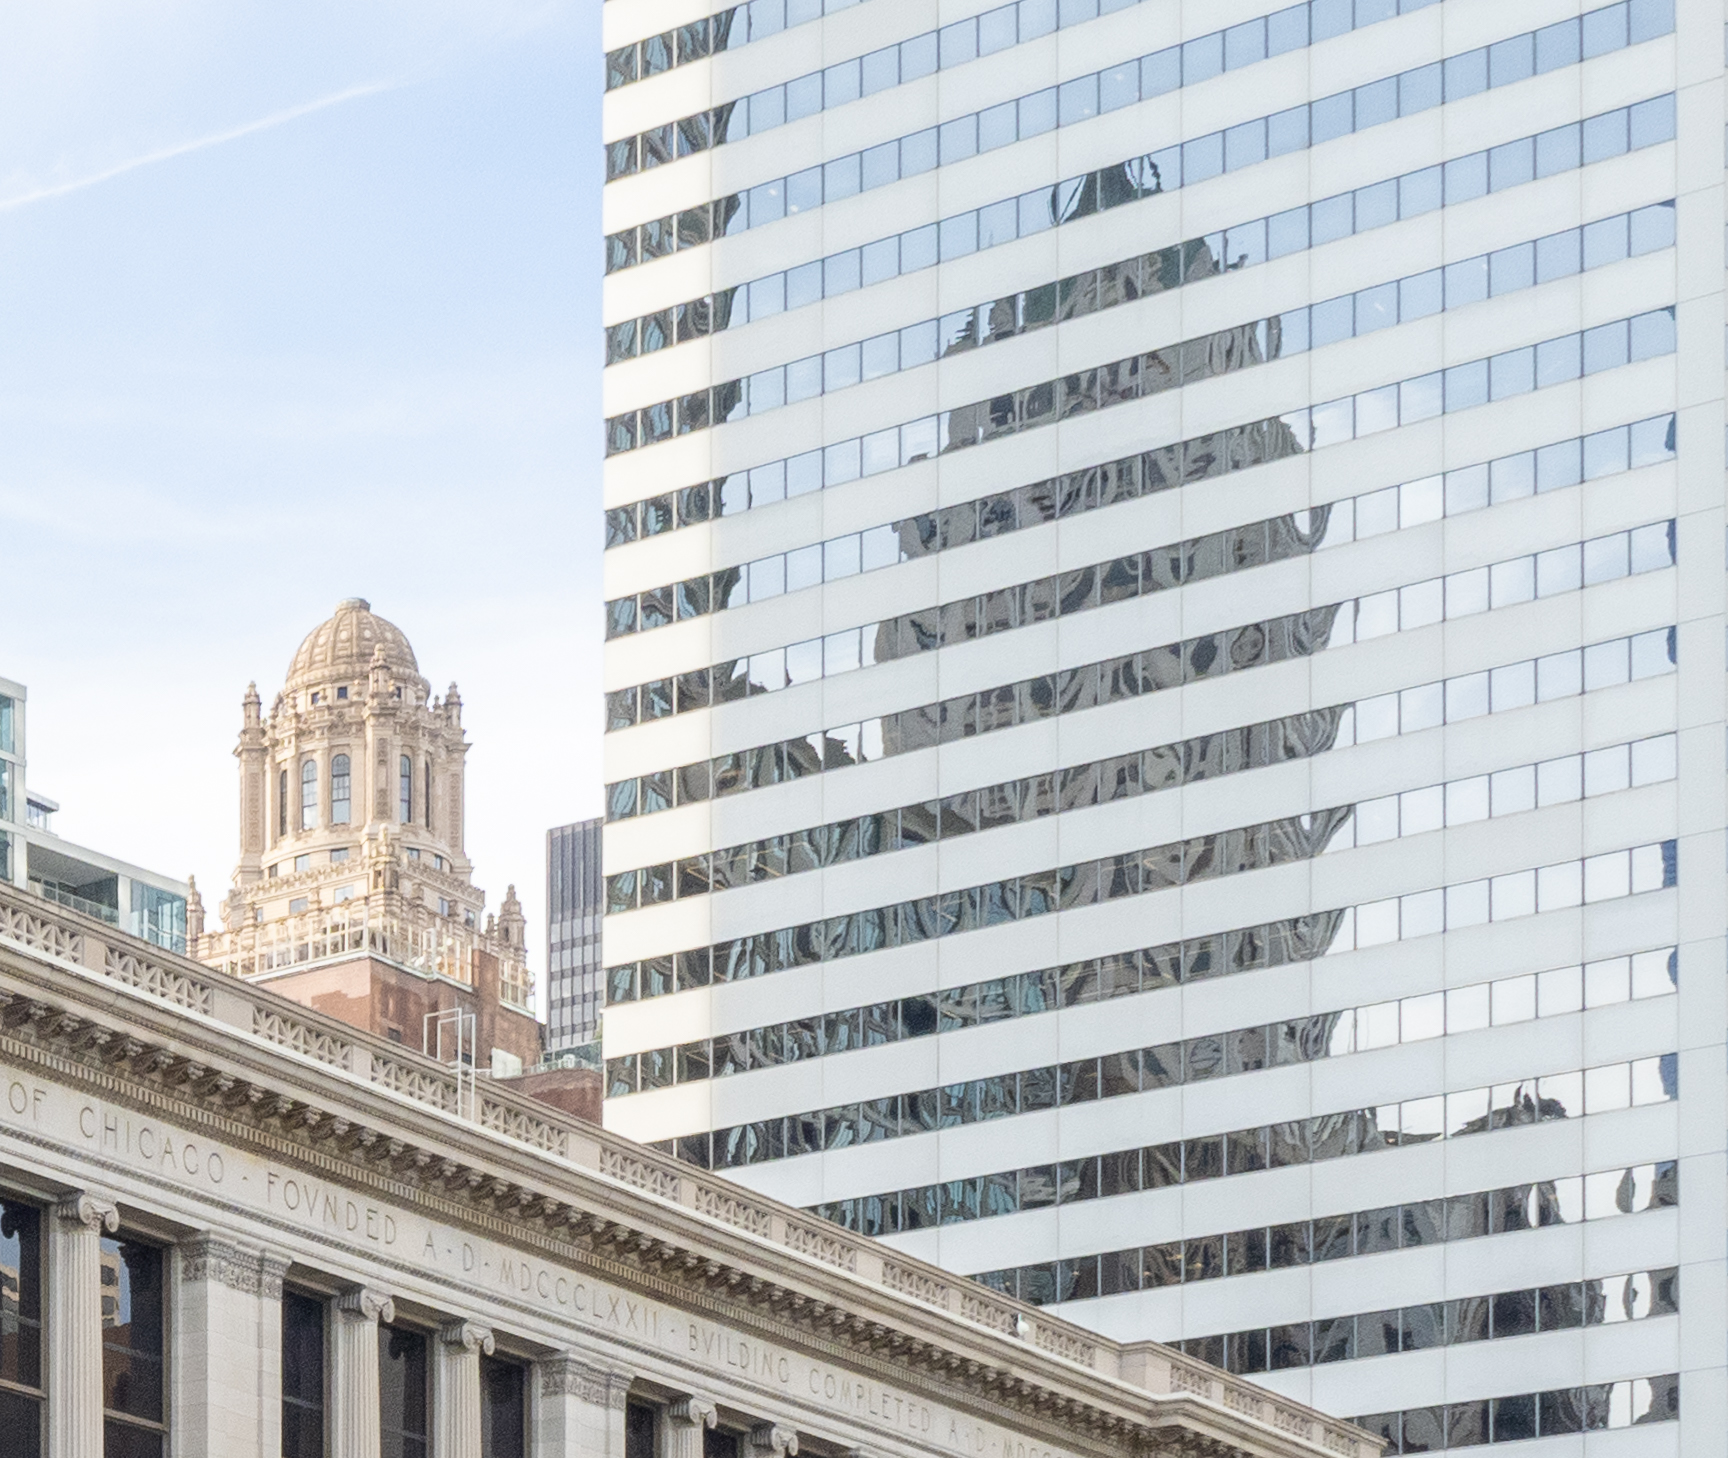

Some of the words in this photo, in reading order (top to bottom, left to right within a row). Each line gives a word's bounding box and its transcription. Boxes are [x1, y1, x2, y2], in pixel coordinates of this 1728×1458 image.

[8, 1080, 48, 1122] OF
[79, 1105, 226, 1184] CHICAGO
[266, 1170, 398, 1246] FOVNDED
[689, 1323, 790, 1383] BVILDING
[808, 1367, 931, 1433] COMPLETED
